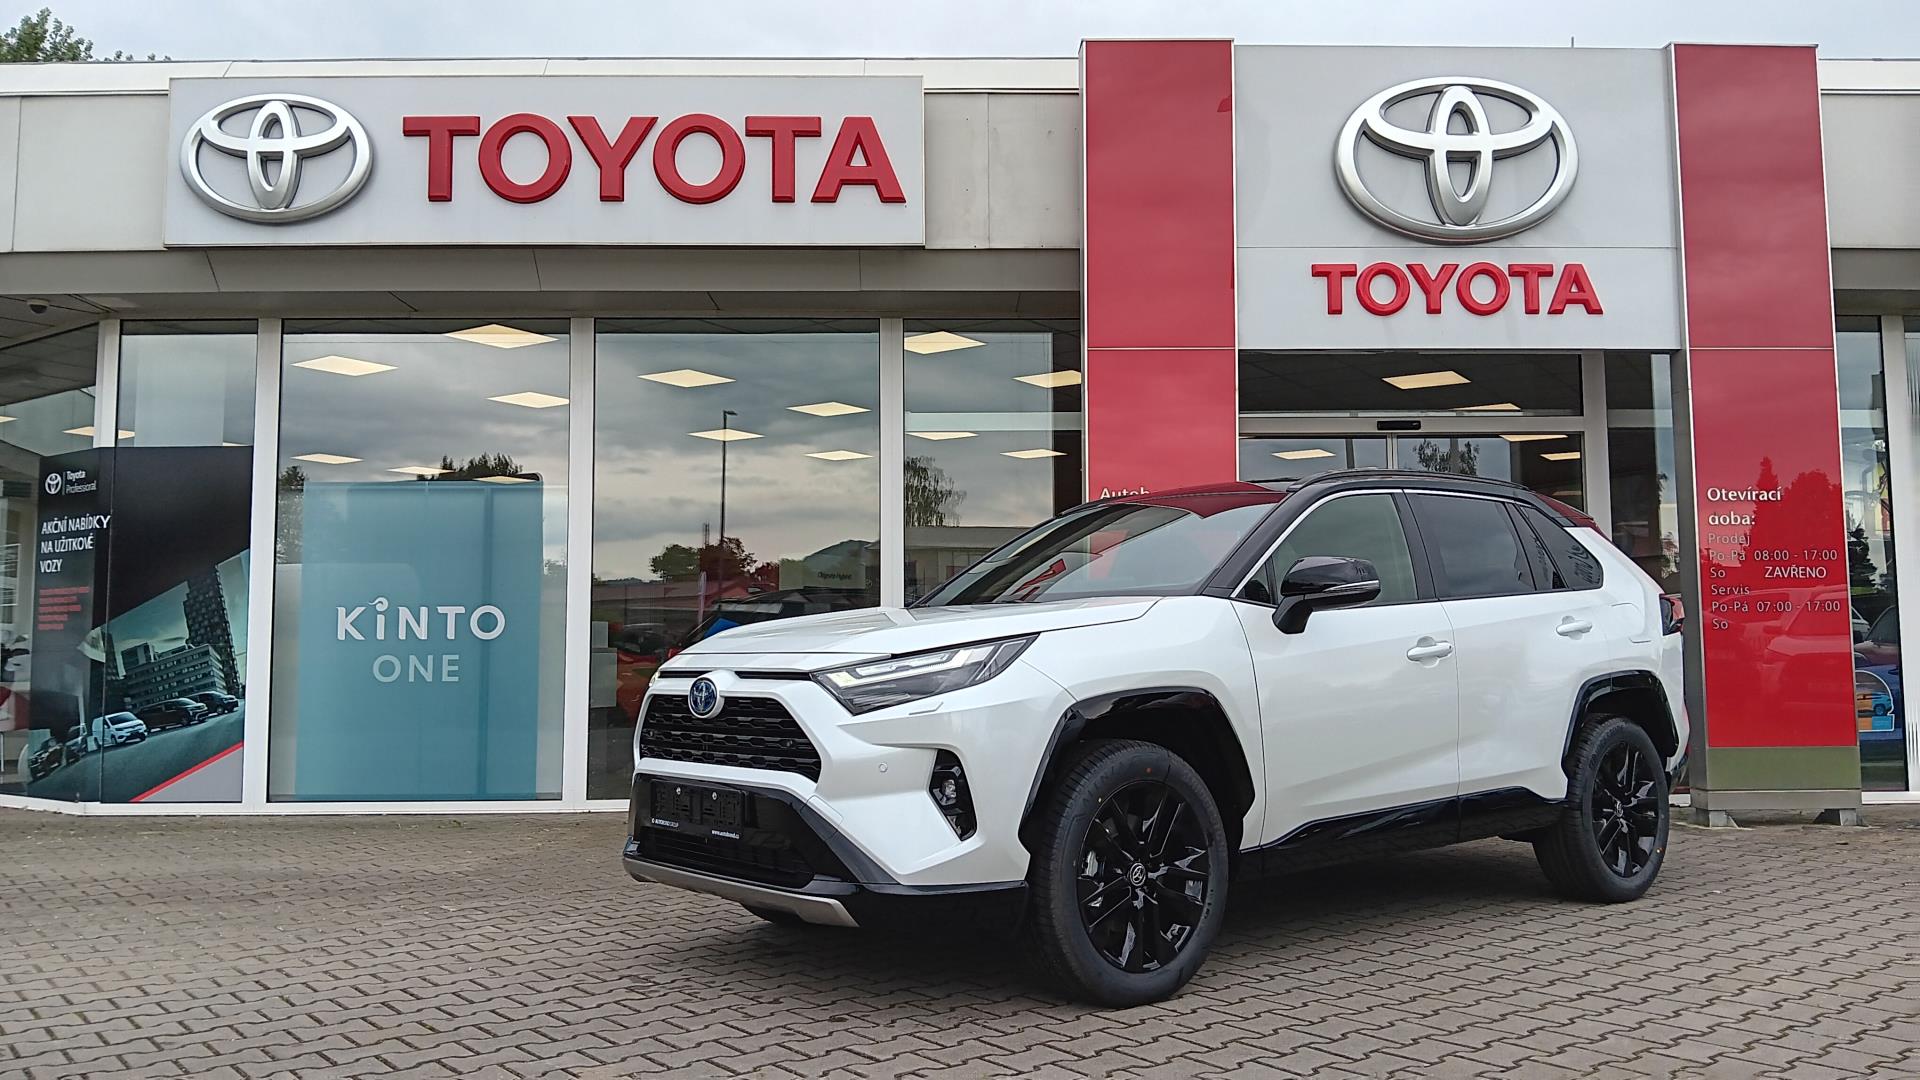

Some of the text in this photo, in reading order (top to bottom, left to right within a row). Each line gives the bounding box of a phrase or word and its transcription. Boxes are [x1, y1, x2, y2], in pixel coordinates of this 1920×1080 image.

[402, 112, 907, 205] TOYOTA
[1310, 262, 1604, 317] TOYOTA
[66, 470, 86, 482] Toyota
[1706, 486, 1782, 501] Otevírací
[41, 513, 111, 535] AKČNÍ NABÍDKY
[1708, 511, 1756, 525] doba:
[40, 532, 94, 554] NA UŽITKOVÉ
[1708, 533, 1751, 547] Prodej
[1753, 549, 1789, 561] 08:00
[1803, 549, 1838, 561] 17:00
[39, 559, 63, 573] VOZY
[1710, 564, 1827, 579] So ZAVŘENO
[1711, 584, 1750, 595] Servis
[1711, 601, 1749, 613] Po-Pá
[1756, 601, 1792, 612] 07:00
[1806, 600, 1841, 612] 17:00
[1712, 618, 1729, 630] So
[372, 654, 460, 683] ONE
